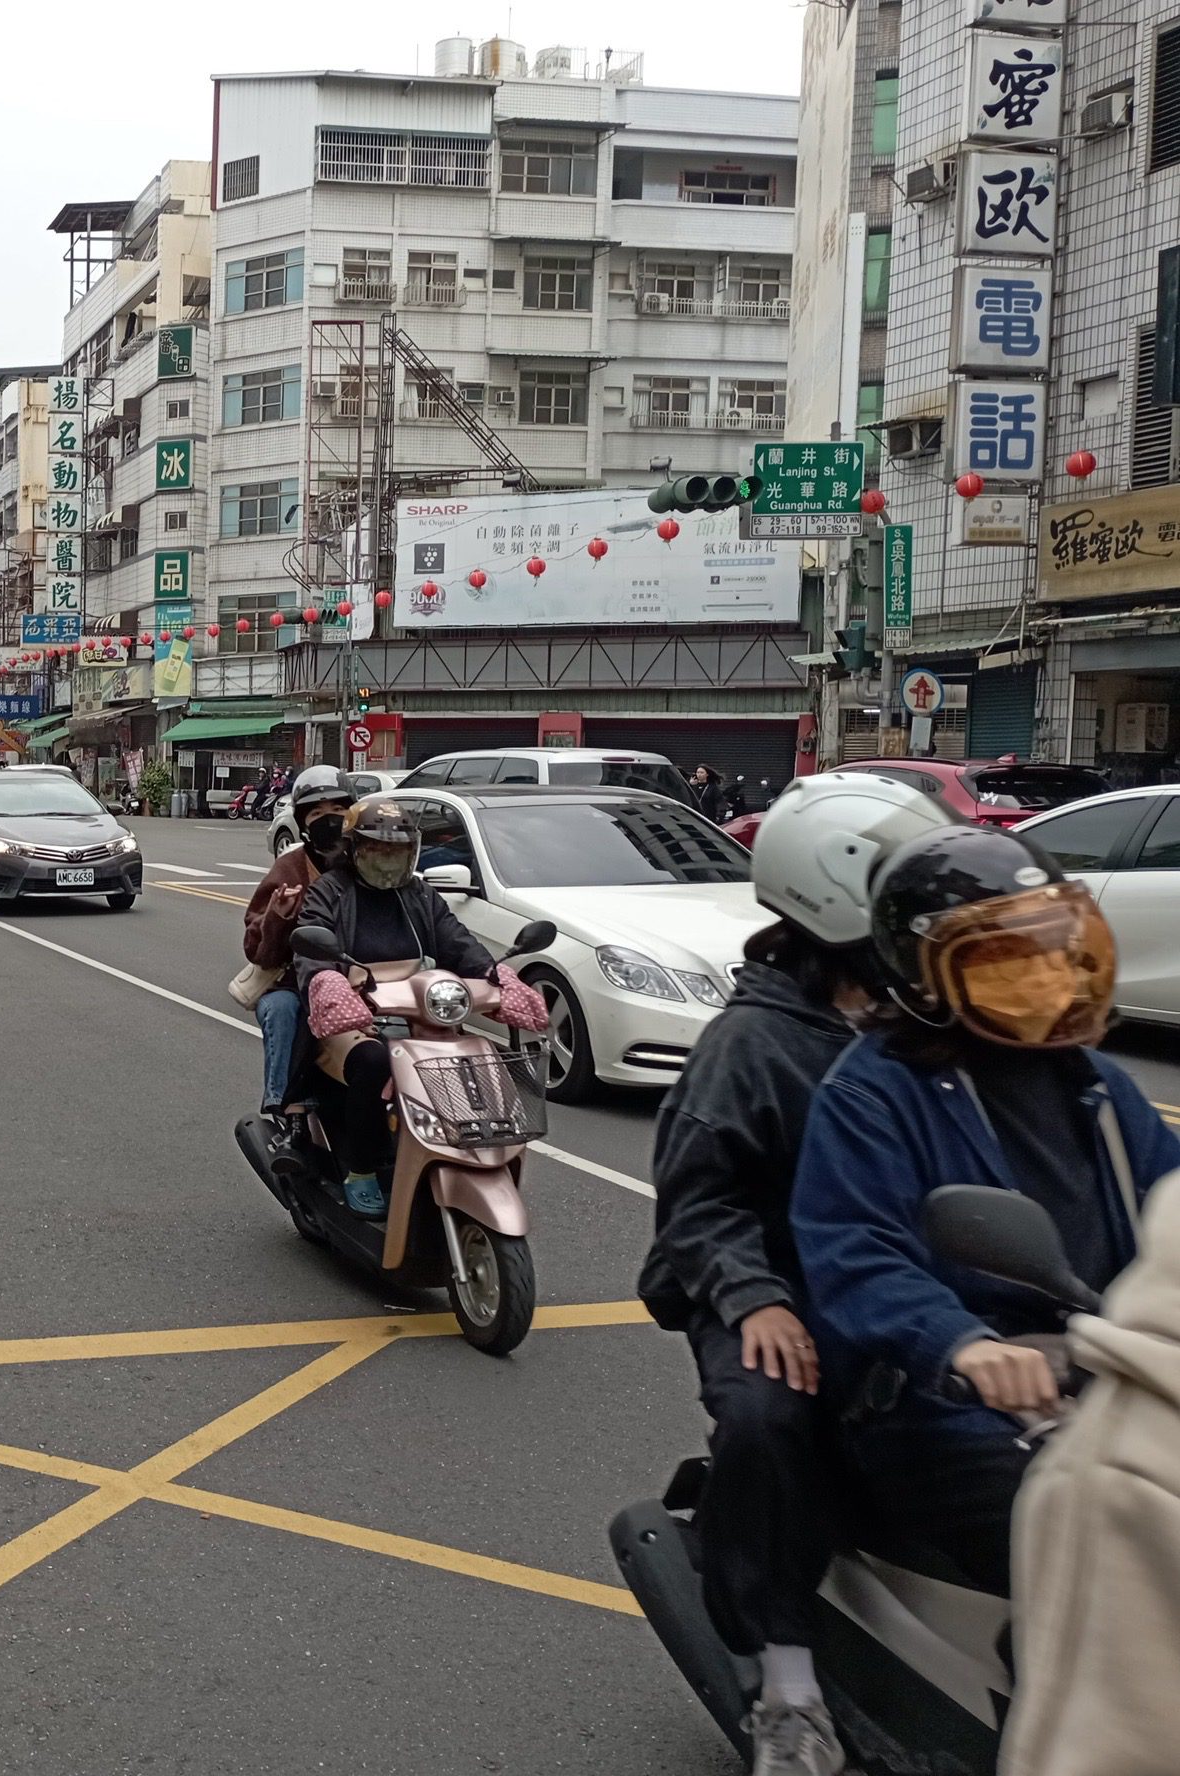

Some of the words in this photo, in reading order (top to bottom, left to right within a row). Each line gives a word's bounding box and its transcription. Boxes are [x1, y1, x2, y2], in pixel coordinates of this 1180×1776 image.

[970, 278, 1042, 471] 電話
[161, 447, 185, 482] 冰
[768, 447, 850, 465] 蘭井街
[779, 466, 817, 478] Lanjing
[823, 466, 837, 477] St.
[766, 481, 849, 499] 光華路
[406, 504, 468, 516] SHARP
[769, 500, 823, 512] Guanghua
[827, 500, 845, 510] Rd.
[428, 518, 455, 527] Original
[476, 523, 580, 540] 自動除菌離子
[160, 558, 184, 592] 品
